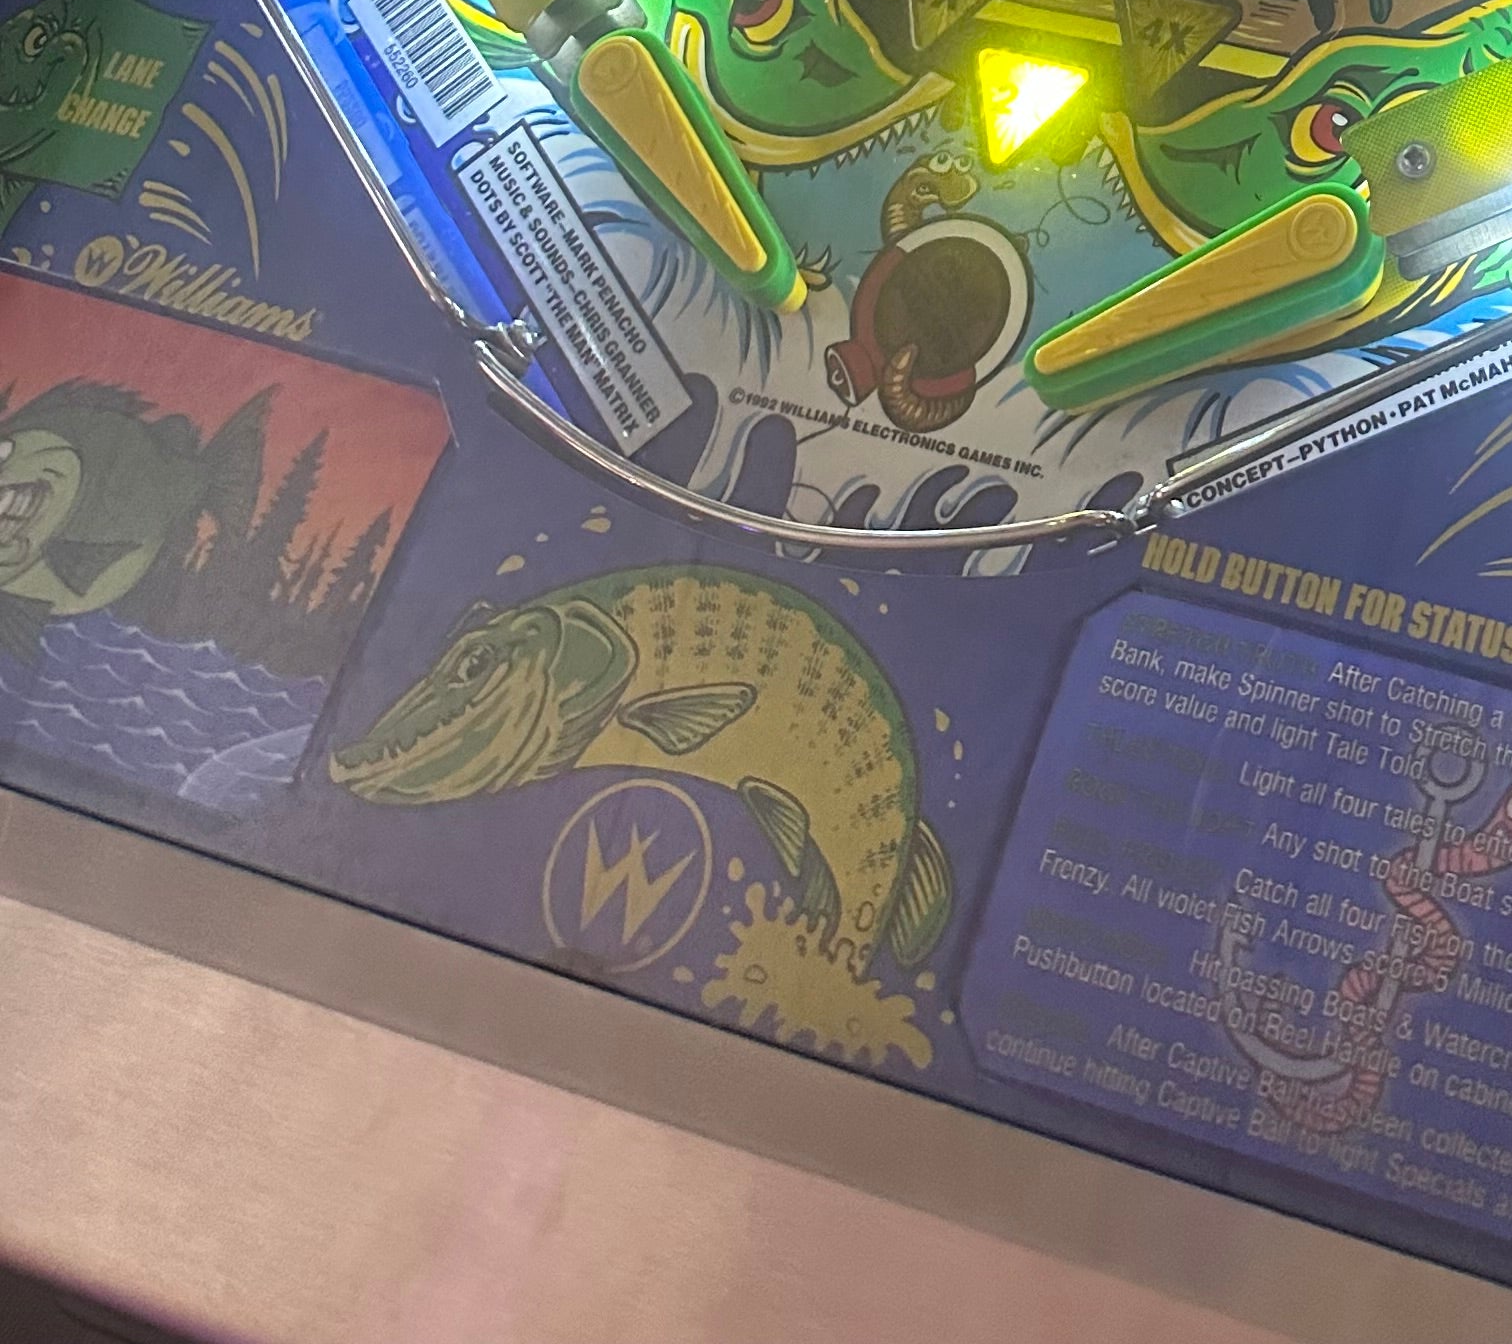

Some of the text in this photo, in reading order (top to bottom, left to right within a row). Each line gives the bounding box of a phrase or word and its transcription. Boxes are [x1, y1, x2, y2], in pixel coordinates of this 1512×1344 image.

[103, 52, 164, 88] LANE
[57, 92, 152, 139] CHANGE
[119, 243, 317, 342] Williams
[470, 169, 502, 214] DOTS
[495, 211, 517, 235] BY
[508, 230, 549, 287] SCOTT
[591, 367, 640, 436] MATRIX
[488, 154, 526, 207] MUSIC
[520, 204, 533, 220] &
[604, 341, 660, 426] GRANNER
[594, 276, 647, 355] PENACHO
[780, 401, 850, 429] WILLIAMS
[852, 419, 955, 455] ELECTRONICS
[958, 446, 1011, 471] GAMES
[1013, 460, 1045, 479] INC.
[1398, 388, 1437, 417] PAT
[1142, 532, 1222, 583] HOLD
[1220, 552, 1342, 616] BUTTON
[1344, 583, 1407, 633] FOR
[1099, 675, 1157, 706] score
[1164, 688, 1219, 723] value
[1224, 708, 1266, 735] and
[1271, 716, 1320, 751] light
[1326, 731, 1369, 764] Tale
[1111, 638, 1165, 676] Bank,
[1173, 657, 1232, 691] make
[1237, 672, 1321, 712] Spinner
[1324, 698, 1373, 729] shot
[1380, 713, 1401, 737] to
[1408, 717, 1488, 761] Stretch
[1327, 662, 1383, 693] After
[1387, 676, 1484, 727] Catching
[1490, 708, 1504, 727] a
[1239, 760, 1296, 798] Light
[1300, 782, 1327, 806] all
[1332, 786, 1379, 819] four
[1384, 803, 1436, 837] tales
[1444, 821, 1466, 845] to
[1261, 821, 1308, 859] Any
[1312, 838, 1363, 874] shot
[1368, 852, 1391, 880] to
[1398, 861, 1433, 891] the
[1441, 871, 1495, 911] Boat
[1120, 874, 1152, 904] All
[1157, 887, 1218, 923] violet
[1221, 902, 1267, 937] Fish
[1272, 918, 1356, 965] Arrows
[1234, 867, 1300, 910] Catch
[1305, 890, 1332, 918] all
[1338, 896, 1386, 935] four
[1391, 914, 1438, 949] Fish
[1447, 932, 1474, 963] on
